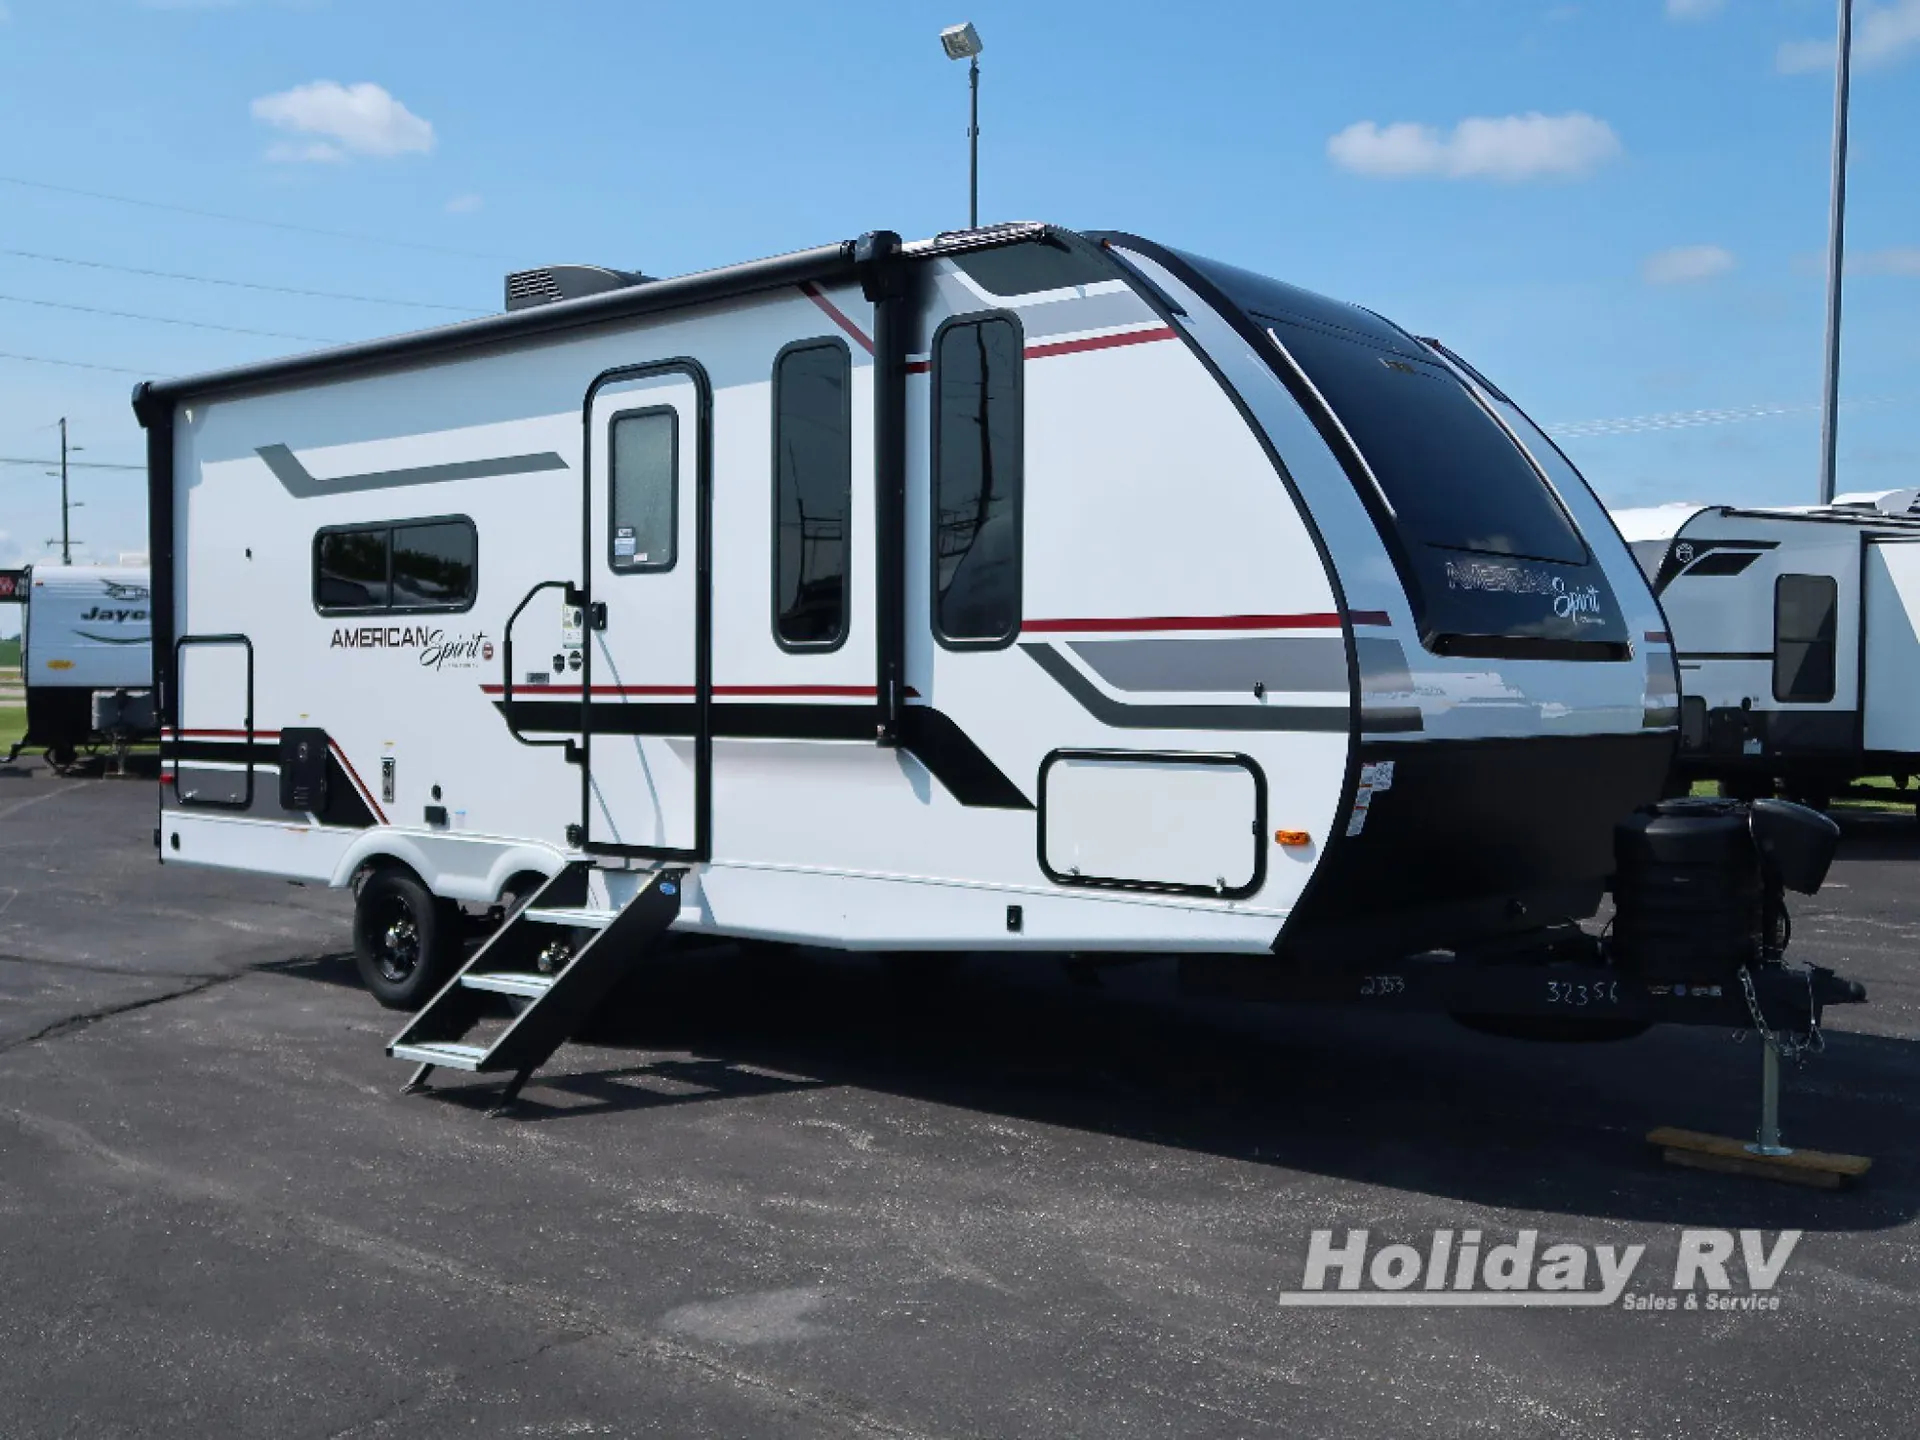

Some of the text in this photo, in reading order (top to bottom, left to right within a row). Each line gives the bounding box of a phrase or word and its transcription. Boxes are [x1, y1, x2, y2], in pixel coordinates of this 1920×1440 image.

[80, 606, 150, 623] Jayc
[1552, 577, 1600, 625] Spirit
[330, 626, 428, 648] AMERICAN
[420, 629, 488, 671] Spirit
[1547, 981, 1619, 1006] 32356
